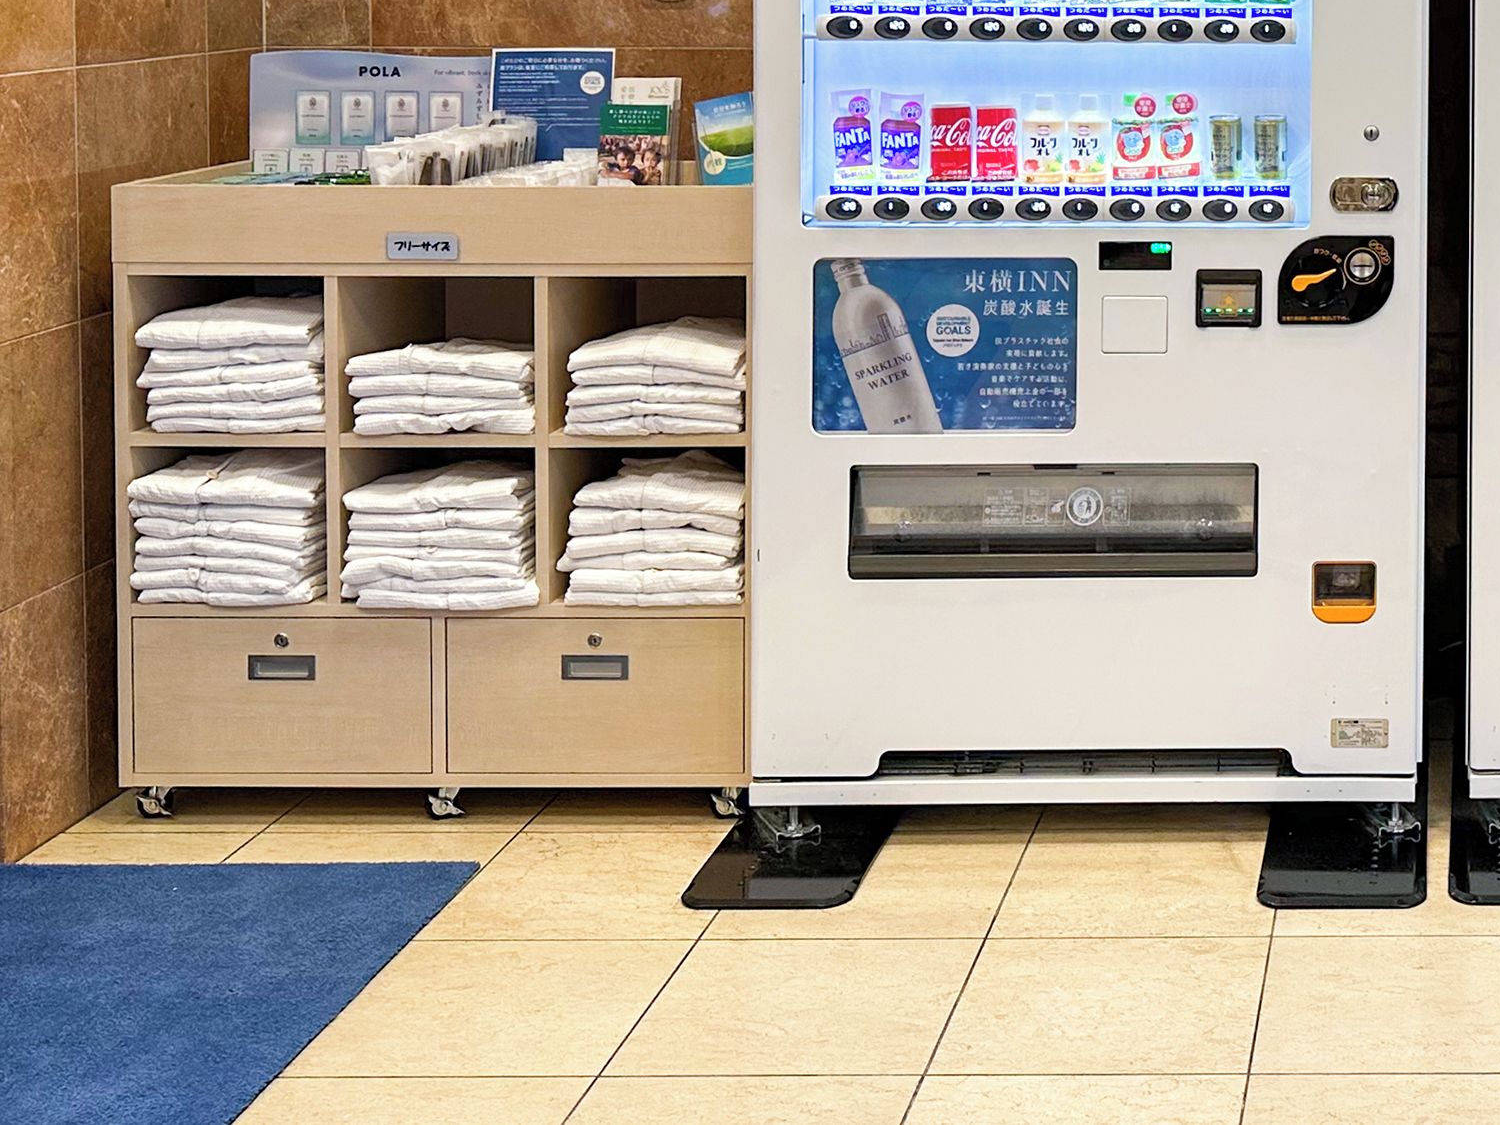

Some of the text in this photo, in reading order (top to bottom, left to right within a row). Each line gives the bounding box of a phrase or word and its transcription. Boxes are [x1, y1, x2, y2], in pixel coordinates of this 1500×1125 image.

[358, 66, 401, 78] POLA
[835, 127, 871, 147] FANTA
[882, 130, 919, 149] FANTA
[1030, 137, 1057, 148] フルーツ
[1072, 137, 1098, 149] フルーツ
[1037, 148, 1050, 156] オレ
[1078, 148, 1091, 156] オレ
[394, 240, 451, 252] フリーサイズ
[963, 269, 1072, 293] 東横INN
[983, 300, 1070, 316] 炭酸水誕生
[936, 325, 971, 335] GOALS
[855, 352, 913, 381] SPARKLING
[867, 369, 910, 391] WATER
